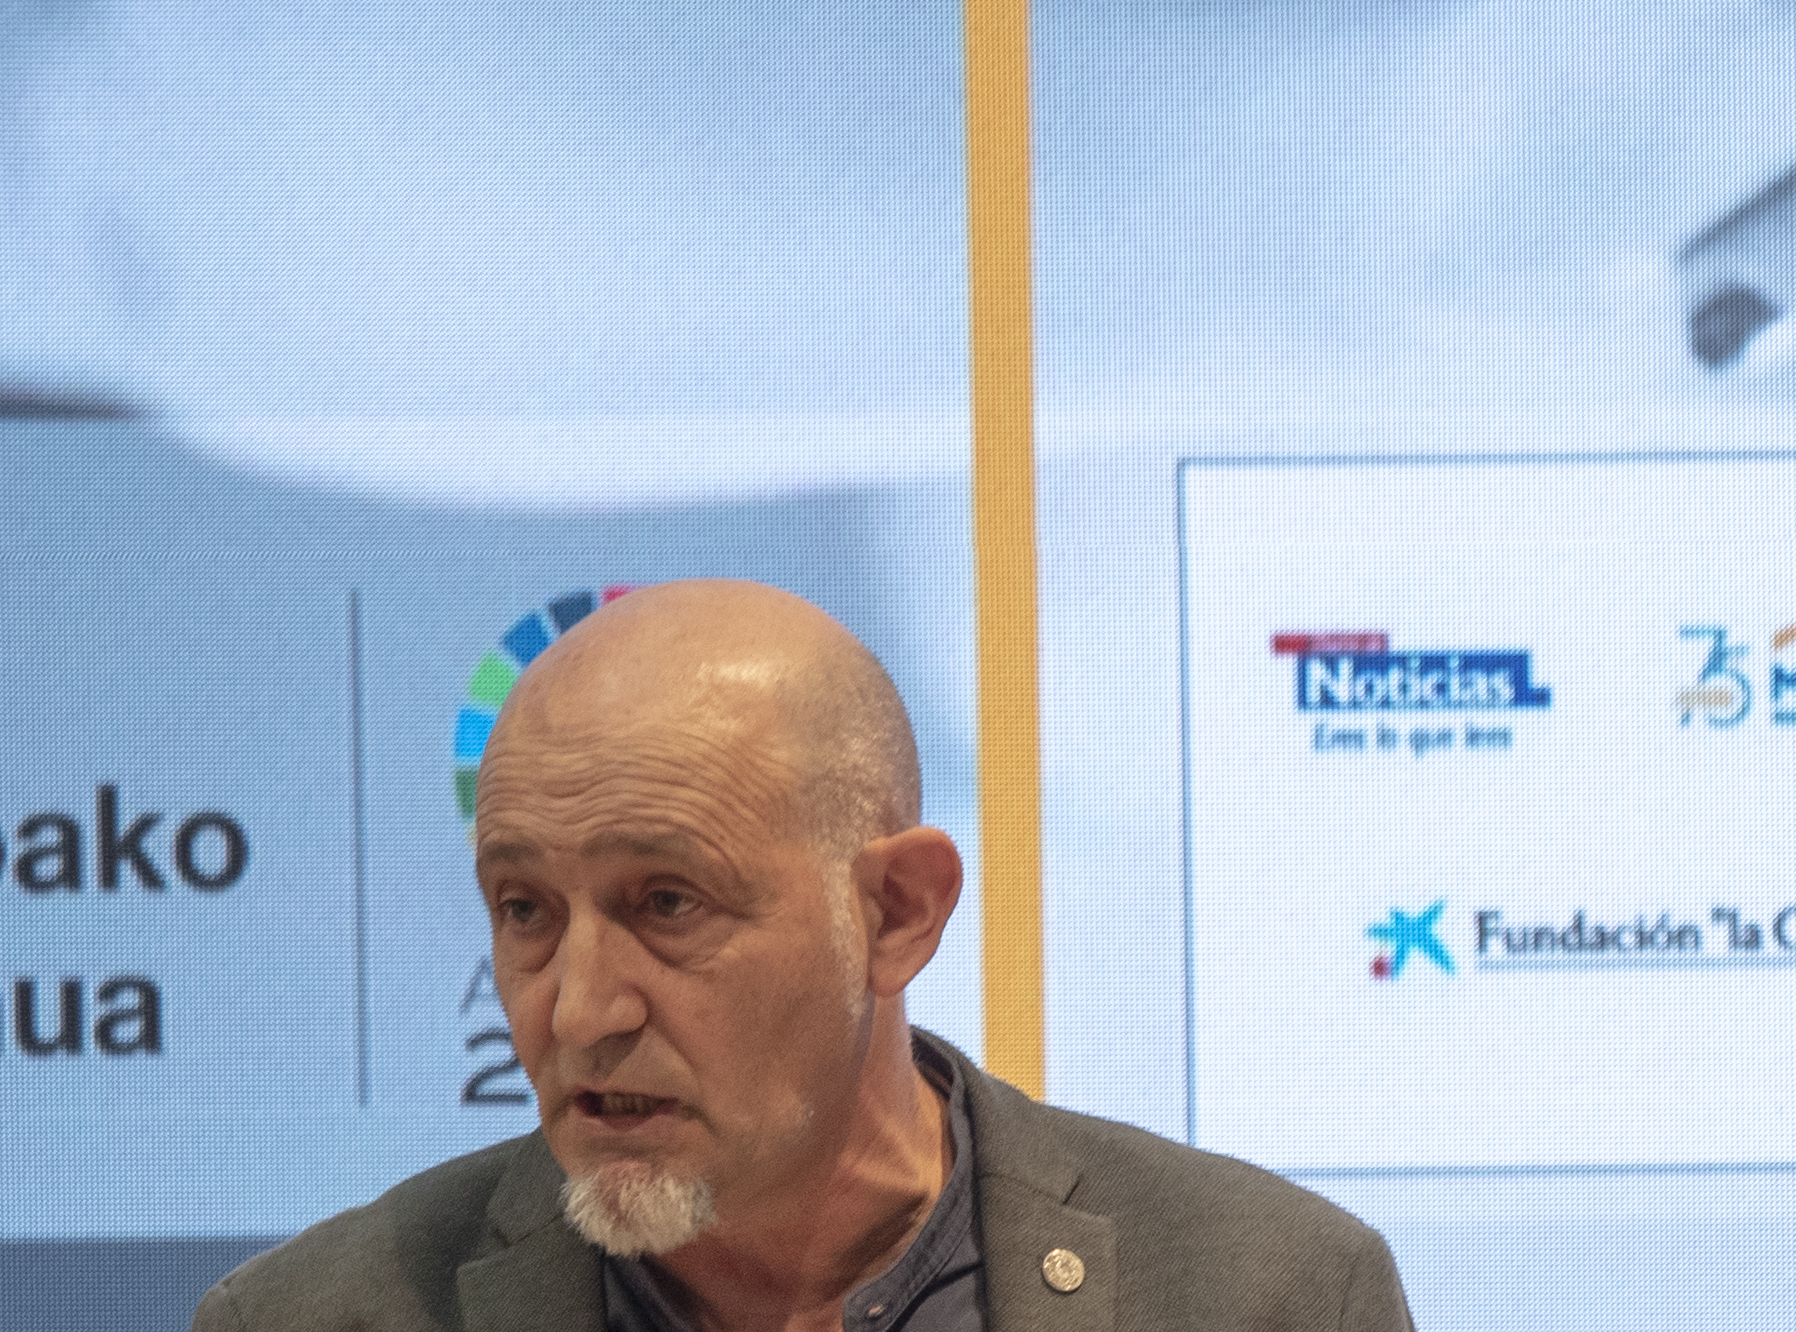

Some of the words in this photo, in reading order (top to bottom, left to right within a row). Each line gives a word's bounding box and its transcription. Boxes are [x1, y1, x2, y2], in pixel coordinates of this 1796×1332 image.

[1305, 656, 1514, 706] Noticias
[0, 783, 250, 893] ako
[1475, 911, 1702, 954] Fundación
